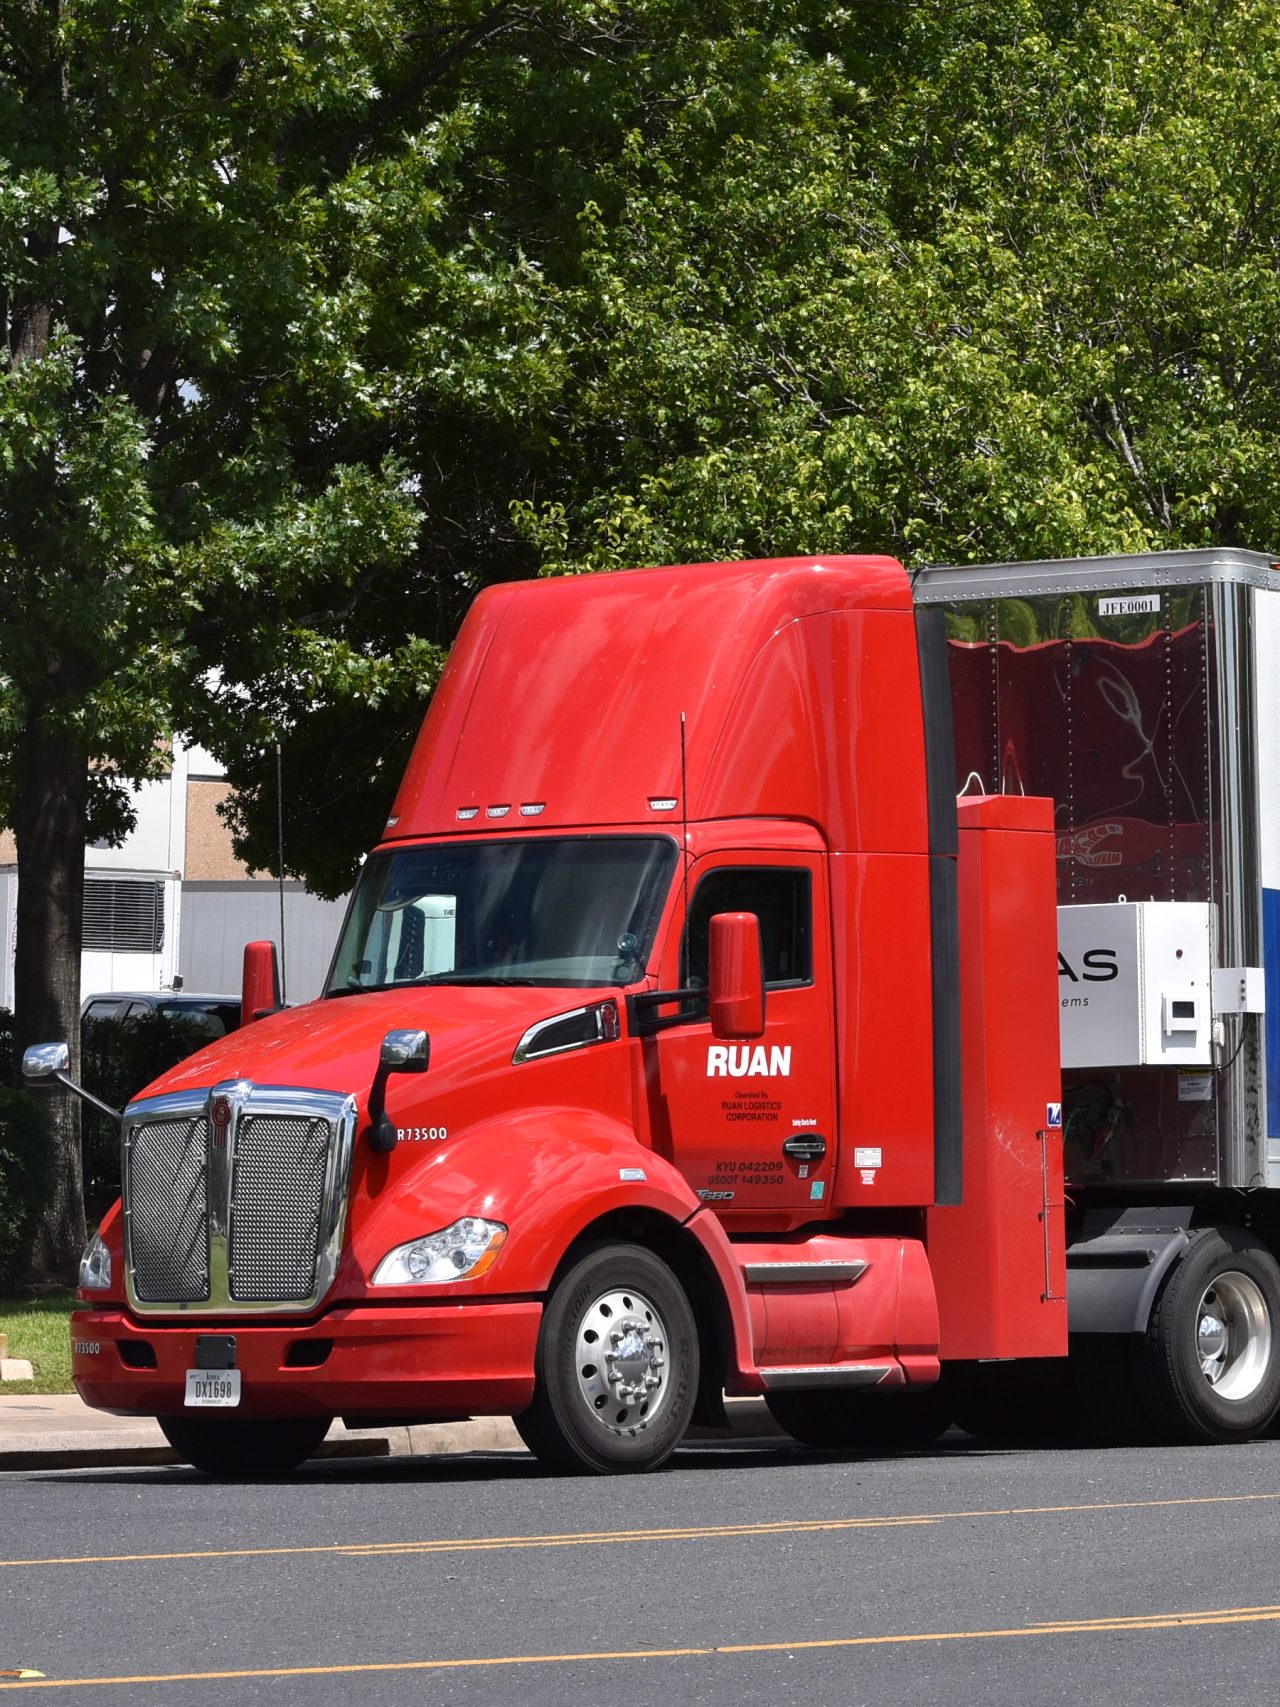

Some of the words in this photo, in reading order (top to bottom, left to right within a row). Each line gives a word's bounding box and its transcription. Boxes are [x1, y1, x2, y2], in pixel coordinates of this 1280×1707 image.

[1103, 600, 1154, 615] JFE0001
[707, 1045, 792, 1077] RUAN
[721, 1101, 743, 1110] RUAN
[744, 1101, 782, 1110] LOGISTICS
[726, 1112, 778, 1121] CORPORATION
[397, 1127, 447, 1141] R73500
[716, 1162, 737, 1172] KYU
[739, 1162, 783, 1172] 042209
[708, 1175, 739, 1185] USDOT
[742, 1174, 784, 1184] 149350
[196, 1381, 232, 1399] DX1698
